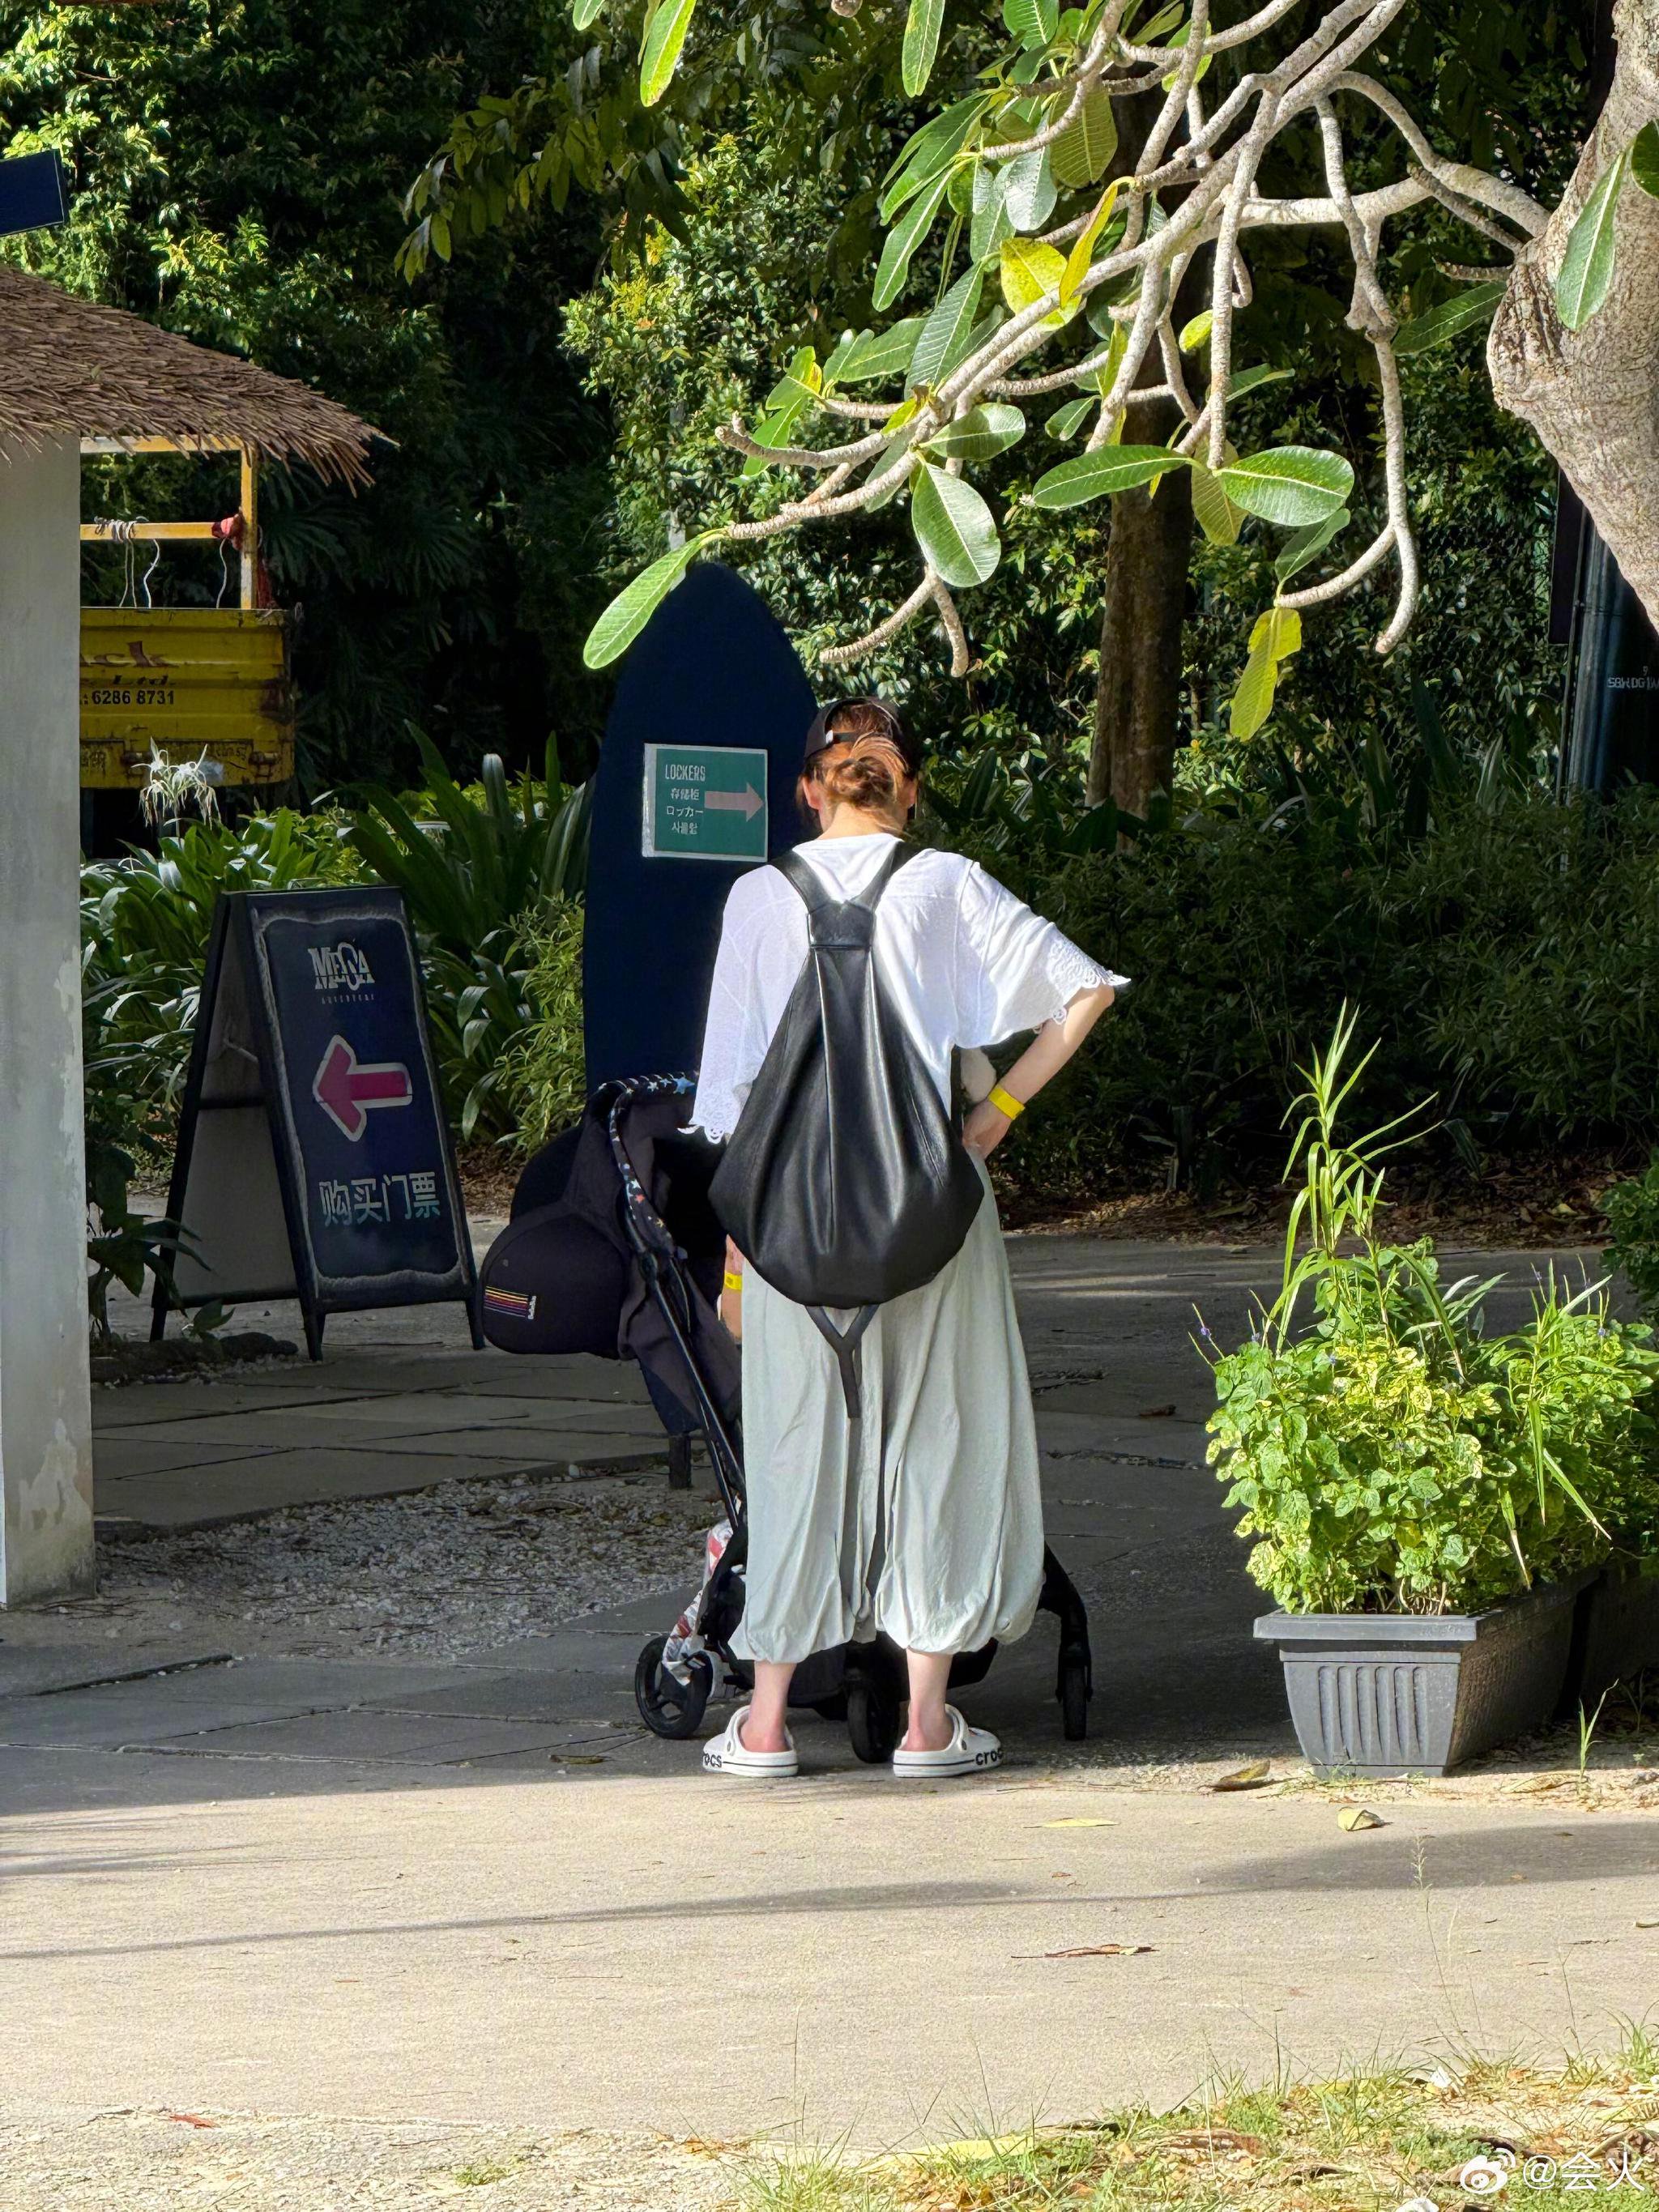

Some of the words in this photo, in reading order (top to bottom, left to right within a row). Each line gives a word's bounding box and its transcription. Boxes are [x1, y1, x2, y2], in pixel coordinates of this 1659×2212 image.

[136, 690, 174, 705] 8731
[665, 764, 706, 782] LOCKERS
[307, 942, 376, 991] MEGA
[318, 1171, 441, 1227] 购买门票
[703, 1753, 723, 1768] ocs
